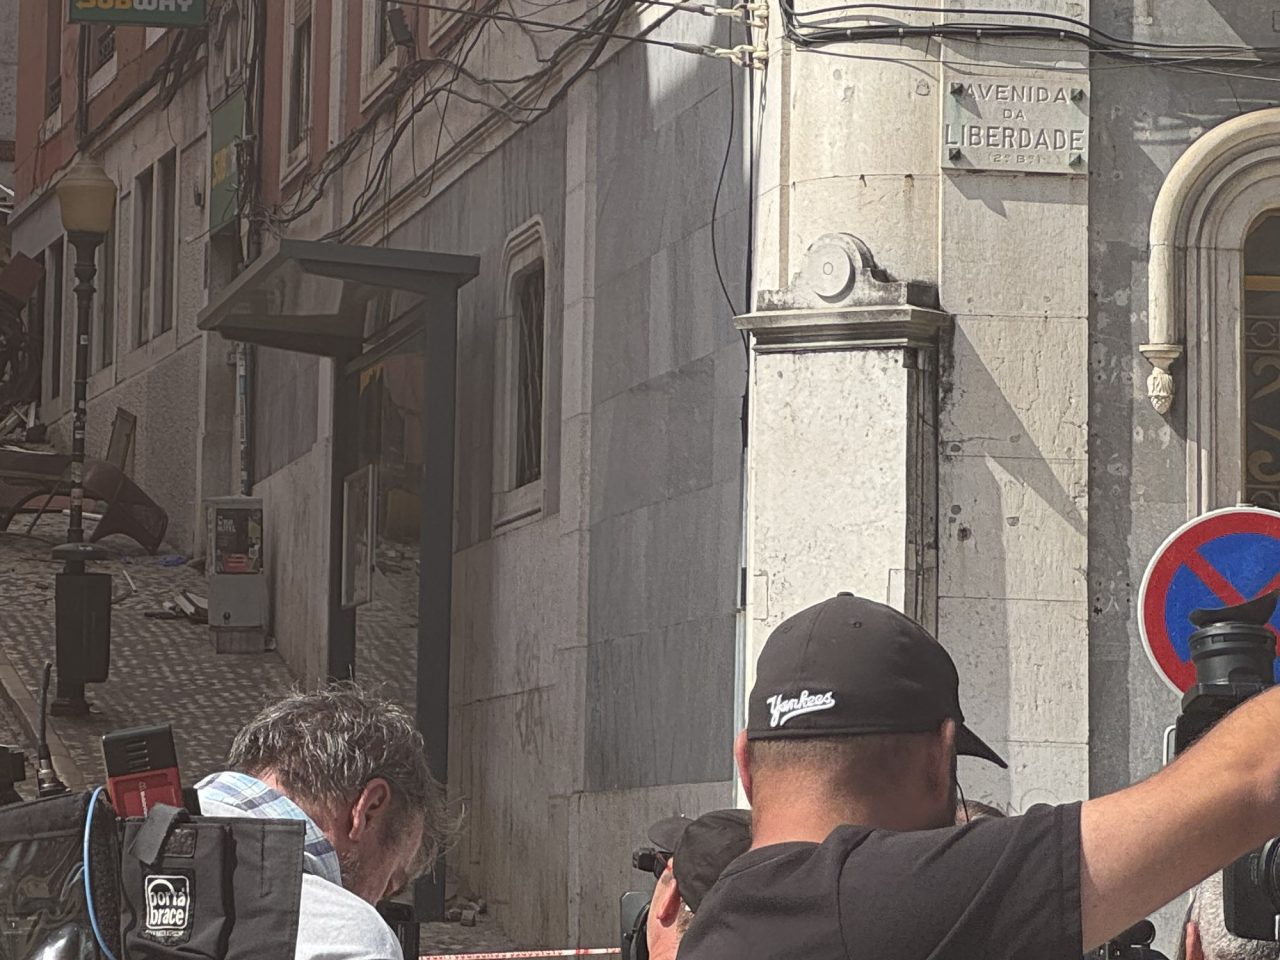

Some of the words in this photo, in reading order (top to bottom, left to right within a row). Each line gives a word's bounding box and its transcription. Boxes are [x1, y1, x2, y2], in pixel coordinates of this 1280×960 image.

[966, 82, 1070, 105] AVENIDA
[1002, 108, 1027, 121] DA
[945, 123, 1085, 152] LIBERDADE
[766, 689, 836, 728] Yankees
[149, 907, 185, 926] brace
